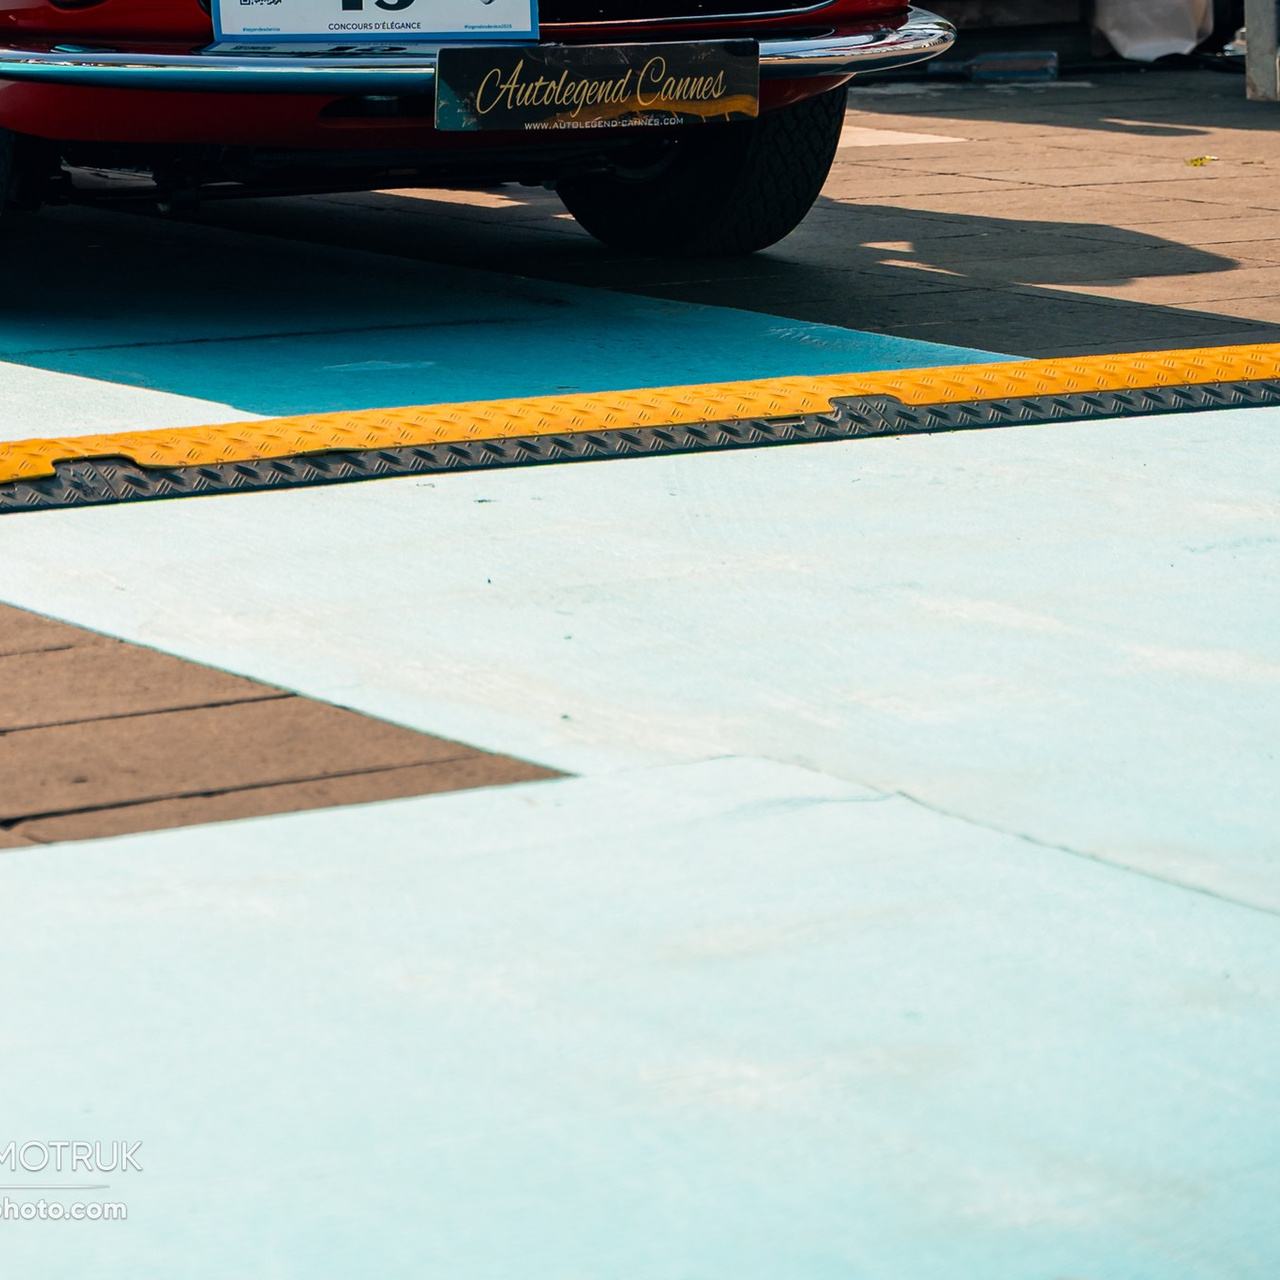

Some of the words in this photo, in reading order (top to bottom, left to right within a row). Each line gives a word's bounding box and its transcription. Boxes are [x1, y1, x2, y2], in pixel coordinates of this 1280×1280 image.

[328, 22, 373, 31] CONCOURS
[374, 21, 421, 30] D'ÉLÉGANCE
[476, 59, 633, 117] Autolegend
[637, 56, 727, 106] Cannes
[524, 117, 684, 130] WWW.AUTOLEGEND-CANNES.COM
